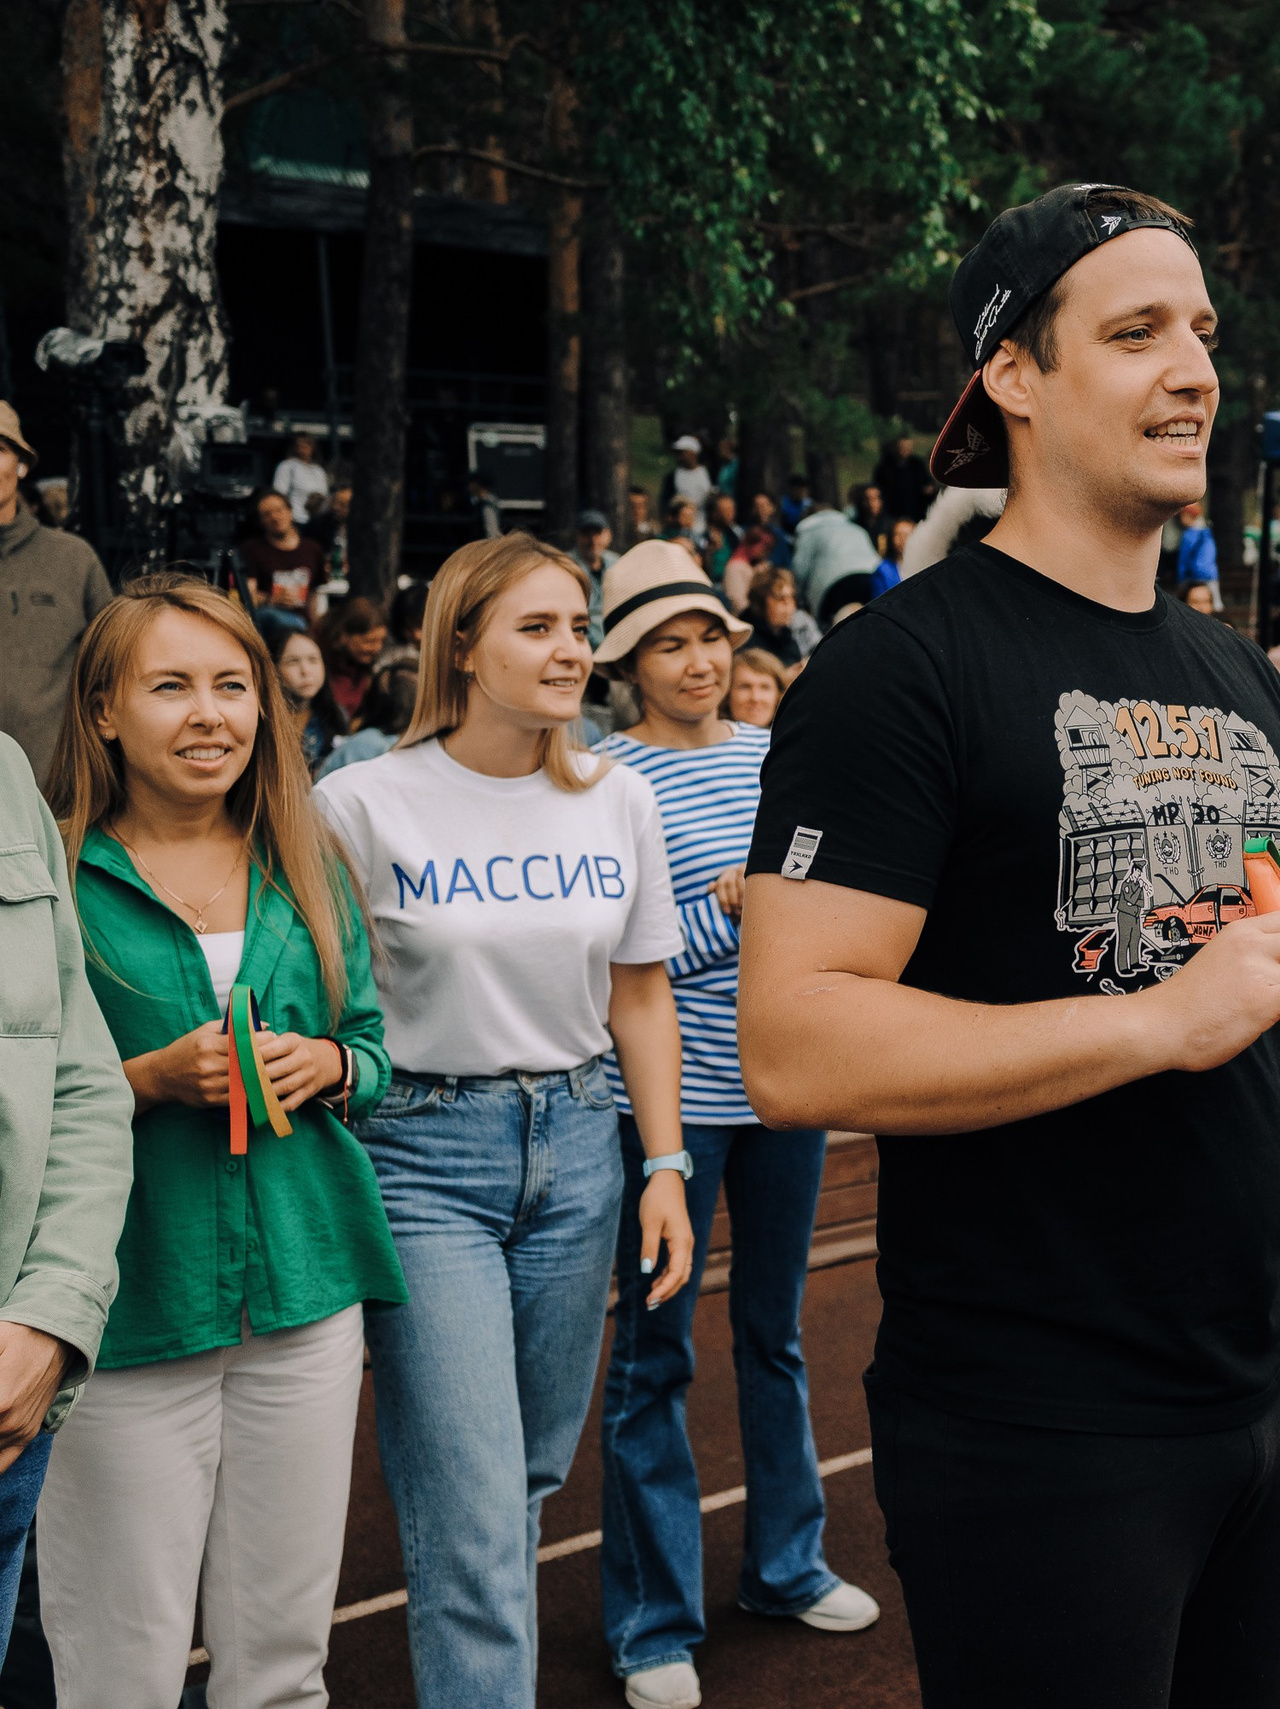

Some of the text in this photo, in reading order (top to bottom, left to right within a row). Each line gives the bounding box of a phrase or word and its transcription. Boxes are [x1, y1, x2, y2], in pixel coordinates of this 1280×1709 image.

[1114, 701, 1223, 763] 12.5.1
[1133, 766, 1239, 791] TUNING NOT FOUND
[391, 854, 625, 909] МАССИВ
